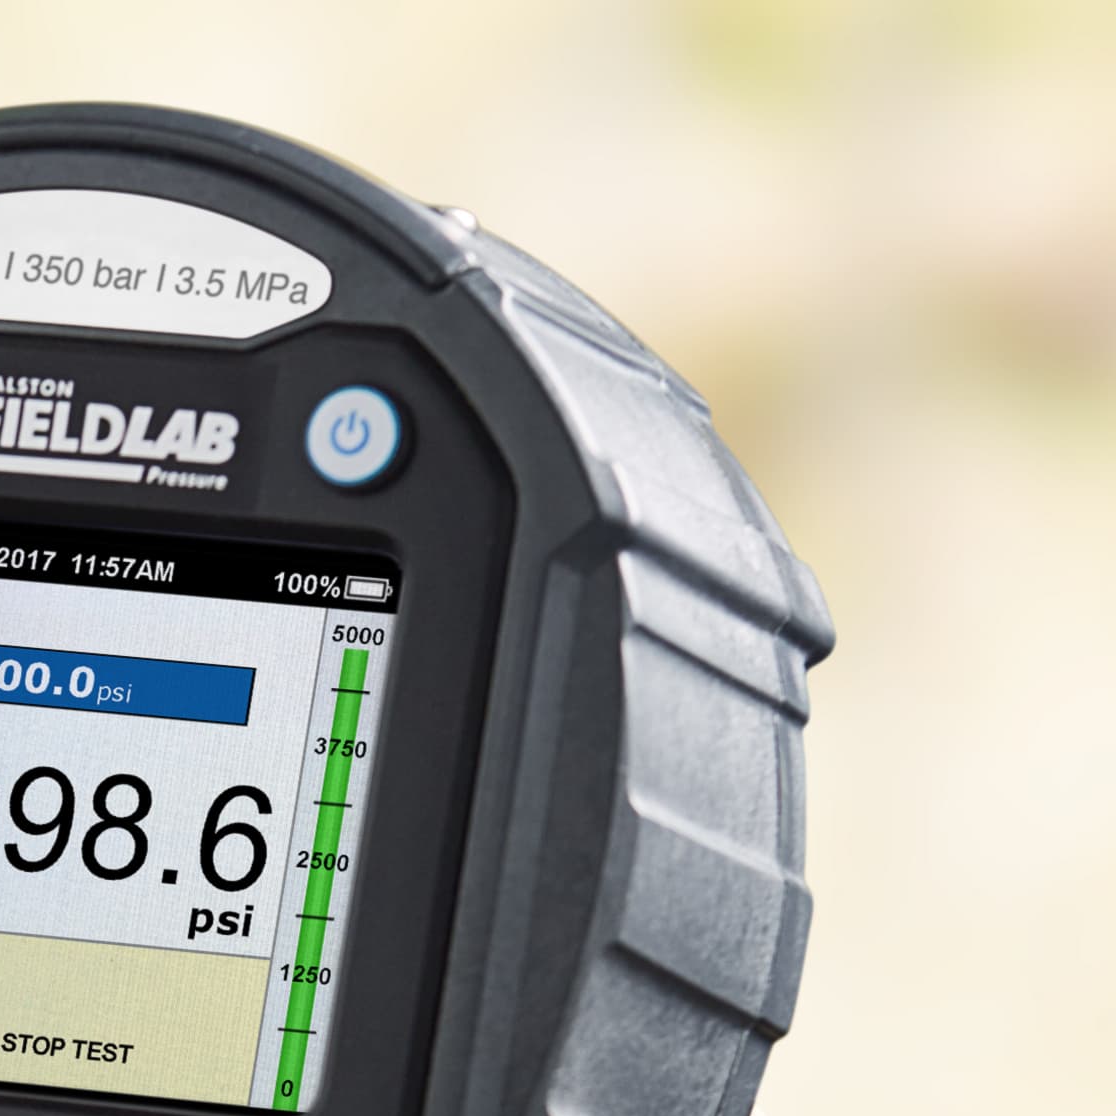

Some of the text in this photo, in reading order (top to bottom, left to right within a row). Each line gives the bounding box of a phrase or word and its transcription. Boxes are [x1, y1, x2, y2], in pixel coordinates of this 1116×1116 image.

[22, 254, 84, 286] 350
[93, 258, 147, 291] bar
[175, 266, 226, 298] 3.5
[235, 270, 309, 305] MPa
[145, 465, 228, 491] Pressure
[70, 553, 175, 583] 11:57AM
[274, 572, 341, 598] 100%
[331, 624, 385, 646] 5000
[96, 683, 133, 705] psi
[314, 736, 367, 760] 3750
[296, 850, 350, 873] 2500
[187, 905, 254, 940] psi
[279, 963, 331, 986] 1250
[0, 1032, 134, 1065] STOP TEST
[281, 1079, 294, 1098] 0
